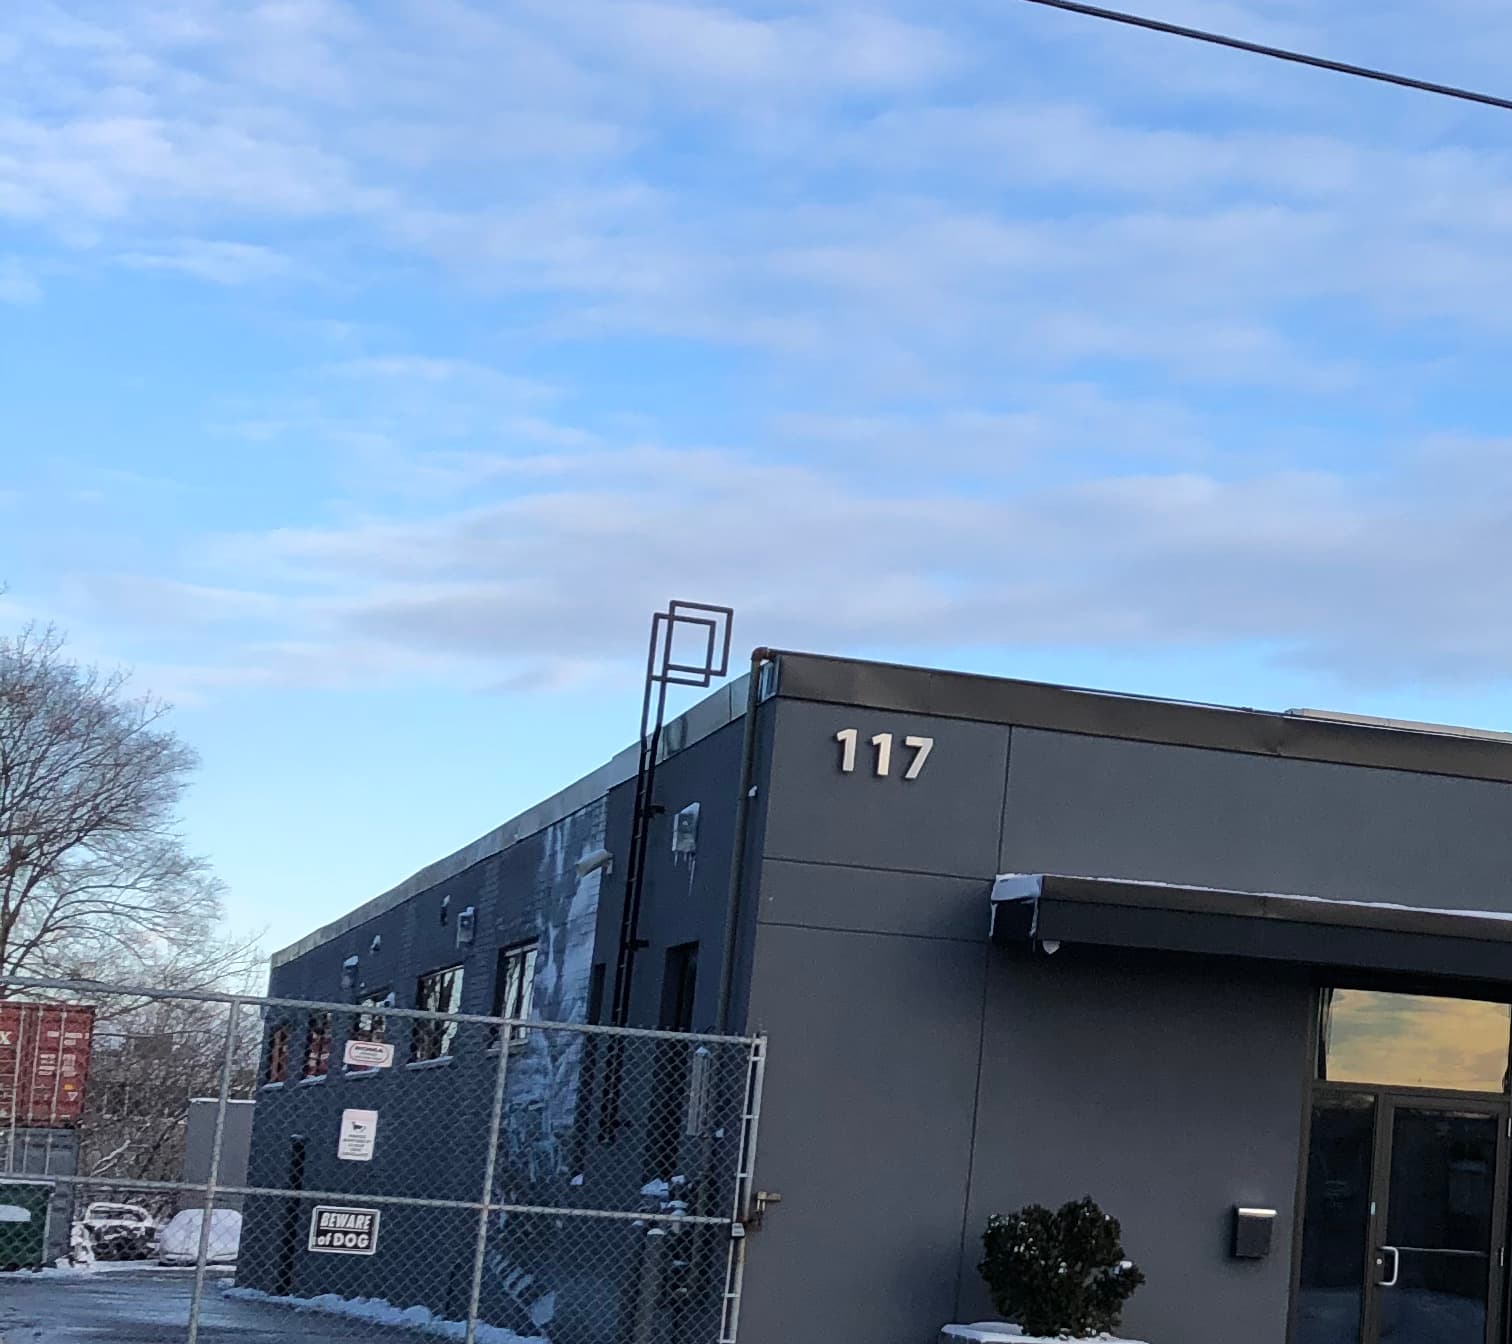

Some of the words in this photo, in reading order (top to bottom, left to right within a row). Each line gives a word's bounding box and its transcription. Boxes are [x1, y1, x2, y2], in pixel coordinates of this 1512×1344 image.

[837, 729, 933, 778] 117
[320, 1212, 371, 1229] BEWARE
[317, 1233, 332, 1245] of
[333, 1233, 369, 1248] DOG
